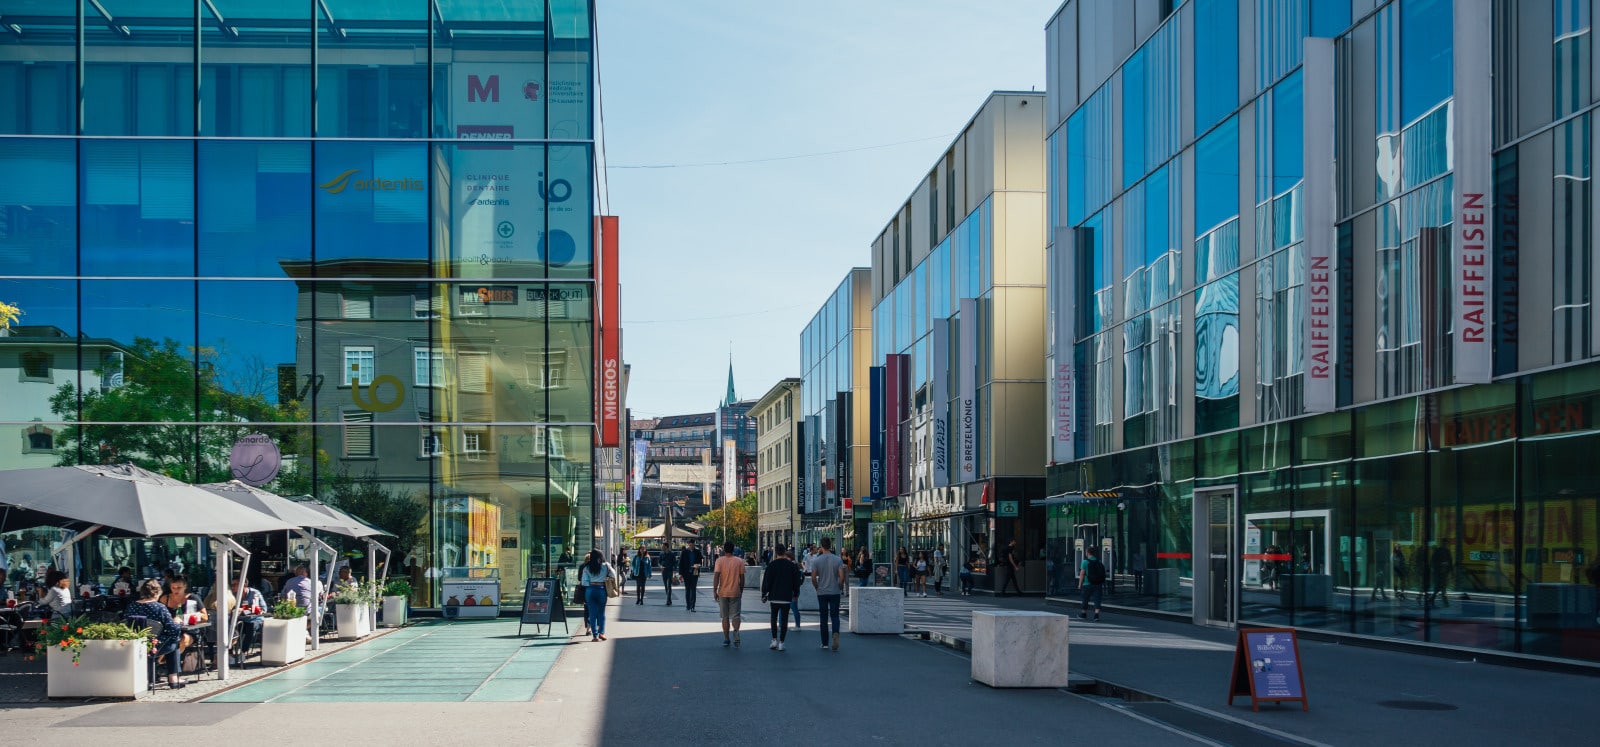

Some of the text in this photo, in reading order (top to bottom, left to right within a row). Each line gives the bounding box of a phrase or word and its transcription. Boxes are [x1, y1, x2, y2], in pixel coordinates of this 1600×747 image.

[467, 75, 500, 103] M
[354, 176, 424, 191] ardentis
[1463, 193, 1485, 343] RAIFFEISEN
[1311, 256, 1329, 379] RAIFFEISEN
[605, 358, 617, 420] MIGROS
[1058, 363, 1070, 442] RAIFFEISEN
[936, 418, 945, 471] VOM FASS
[963, 399, 972, 461] BREZELKÖNIG
[1444, 400, 1583, 447] RAIFFESEN
[872, 459, 880, 493] okaïdi
